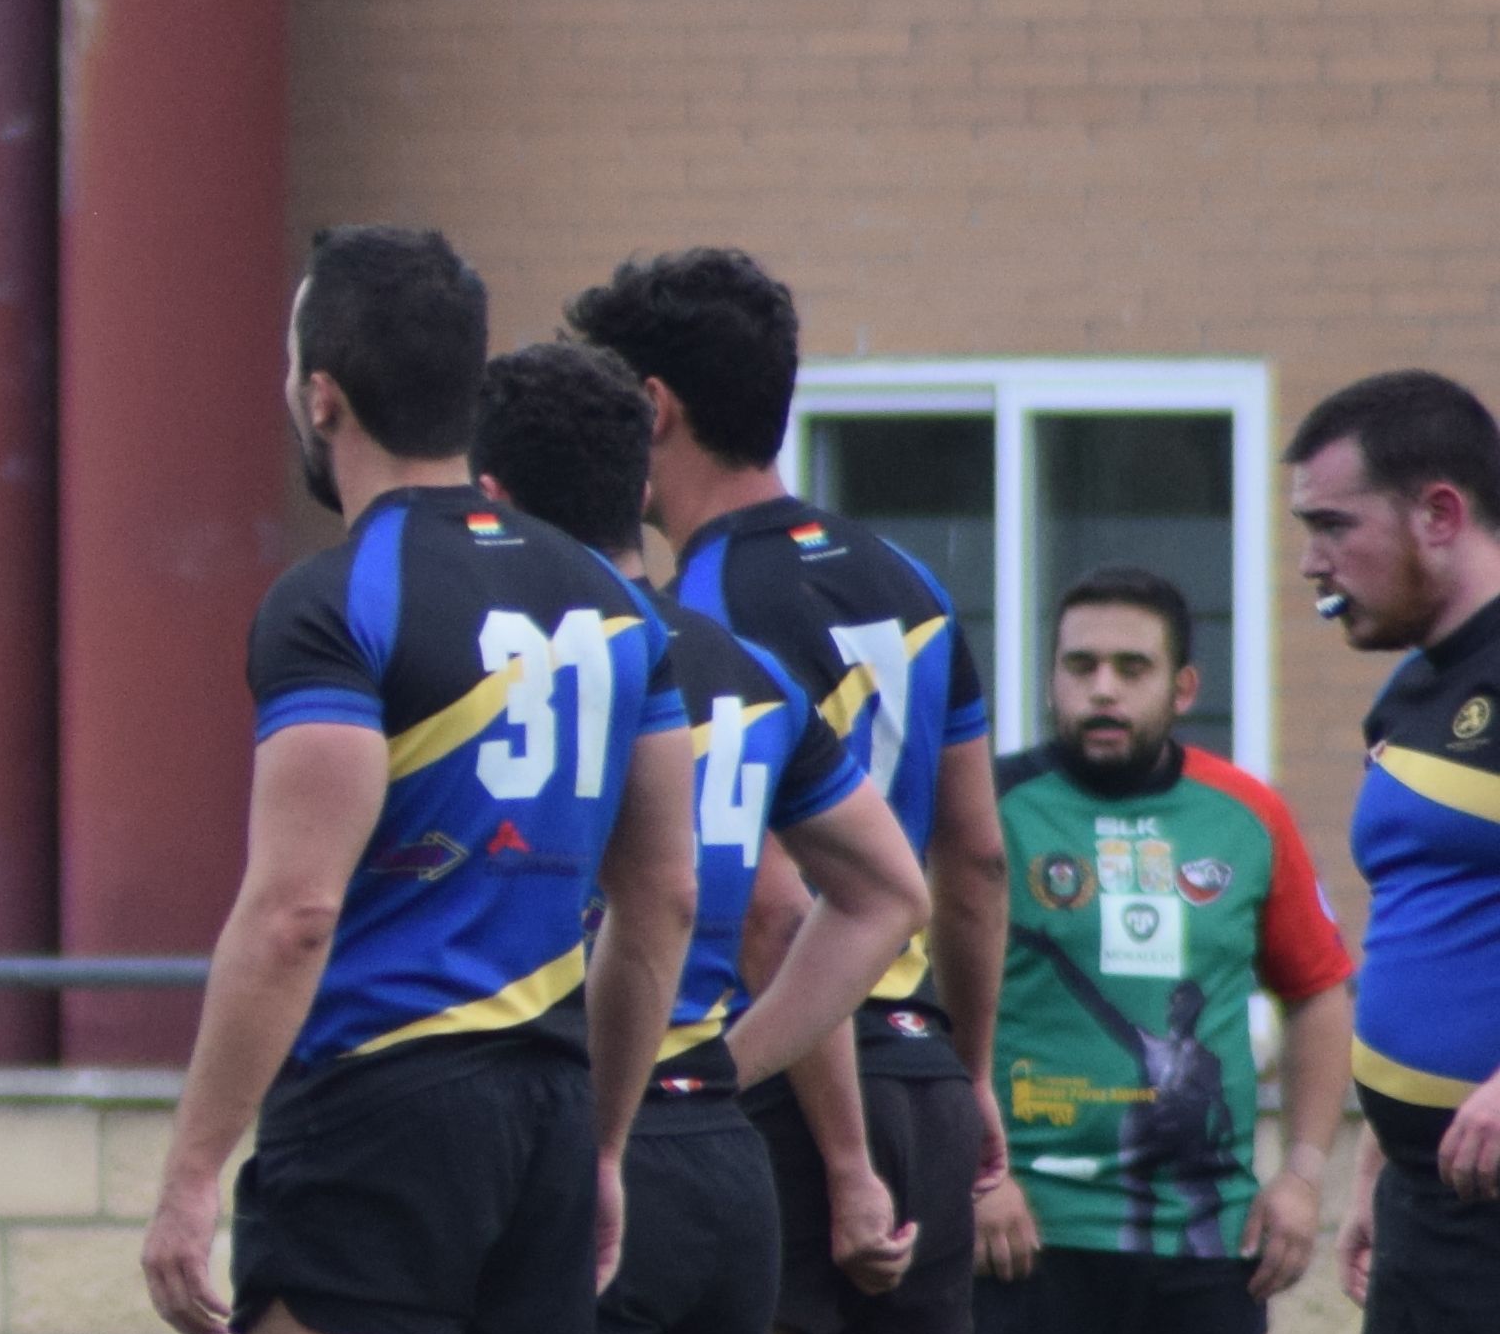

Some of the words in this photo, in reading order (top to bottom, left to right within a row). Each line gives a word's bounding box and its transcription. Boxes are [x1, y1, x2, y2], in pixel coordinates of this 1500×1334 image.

[475, 608, 615, 800] 31
[694, 696, 769, 868] 4
[828, 618, 911, 799] 7
